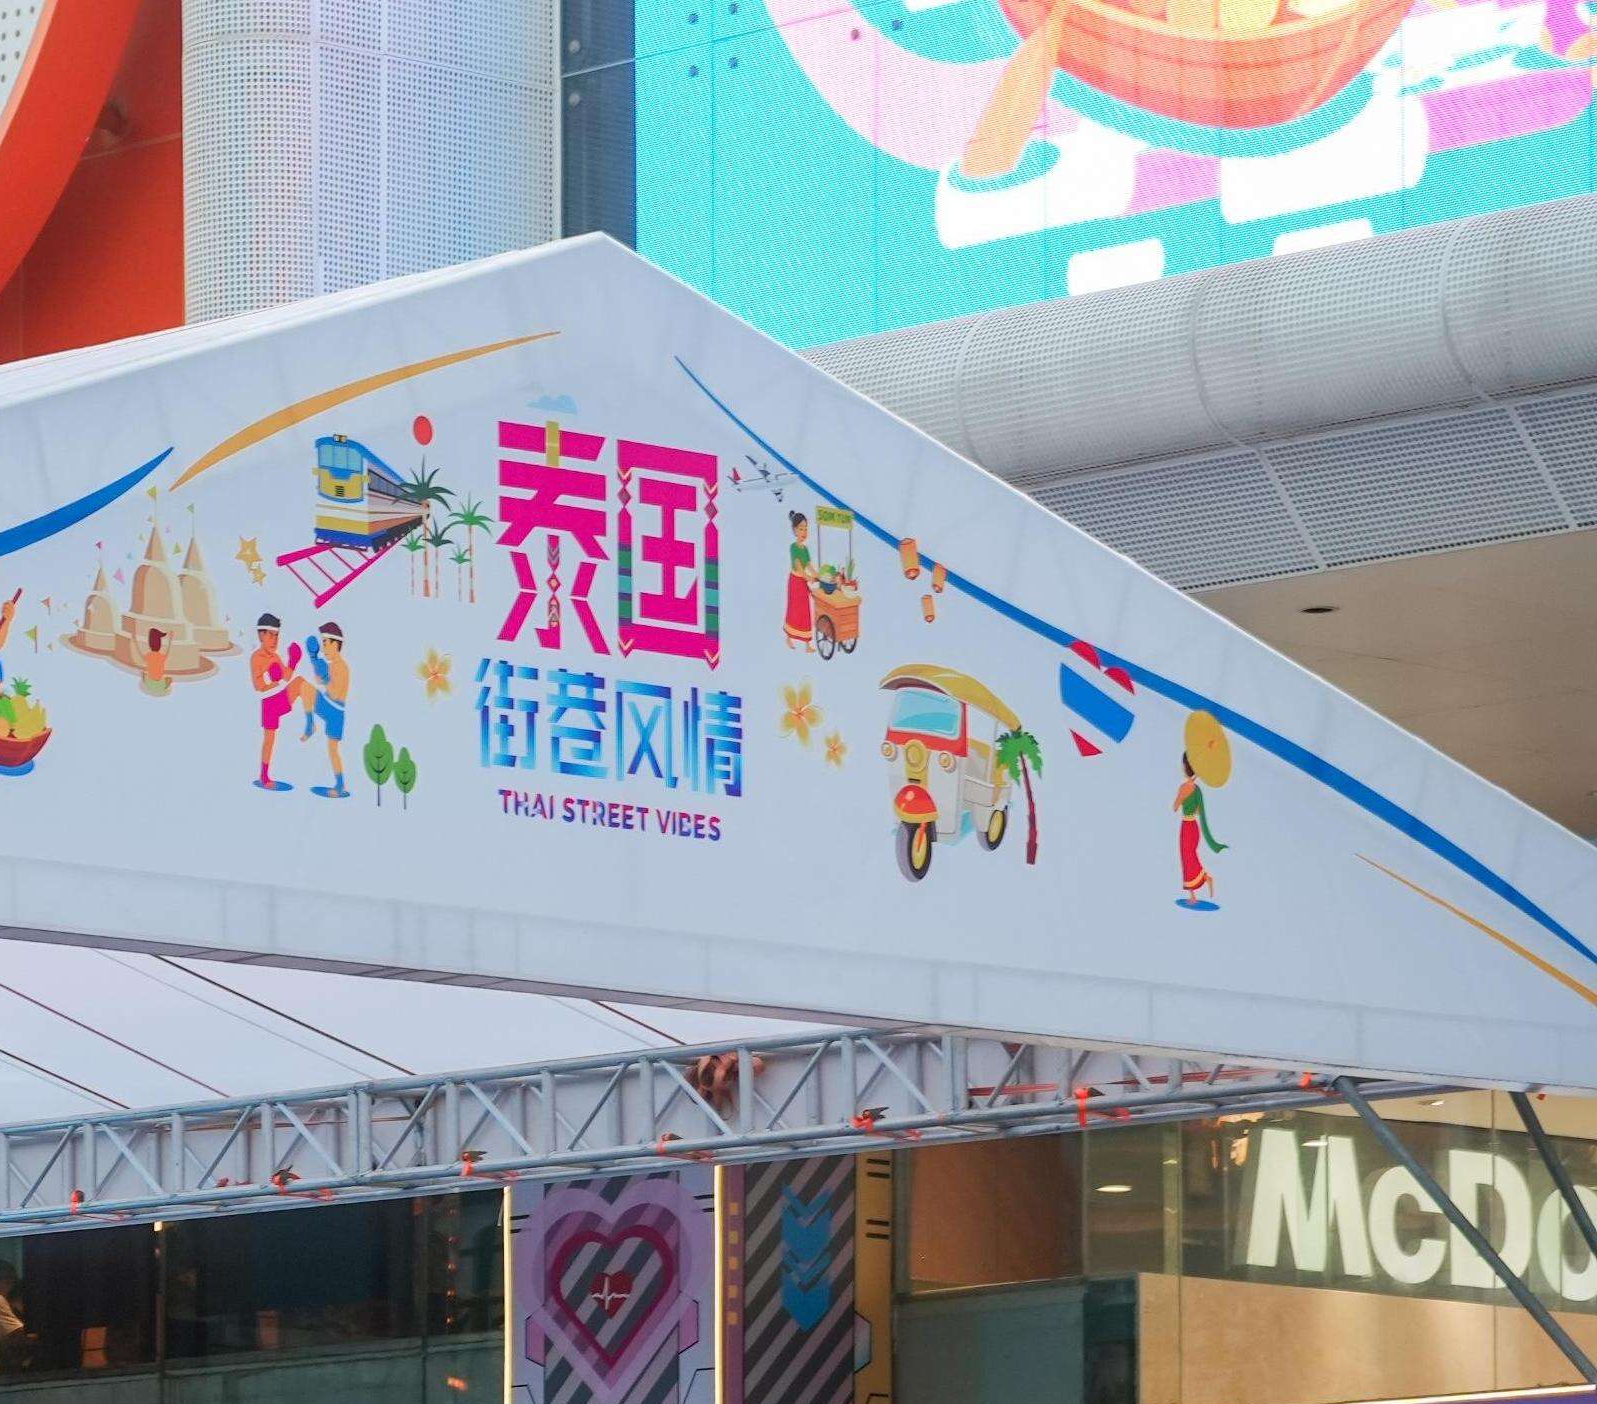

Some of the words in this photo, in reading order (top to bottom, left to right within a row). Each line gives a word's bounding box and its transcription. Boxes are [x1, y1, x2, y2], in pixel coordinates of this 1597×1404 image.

[495, 420, 720, 670] 泰国
[474, 656, 743, 798] 街巷风情
[498, 788, 554, 819] THAI
[562, 797, 649, 831] STREET
[656, 808, 721, 842] VIBES
